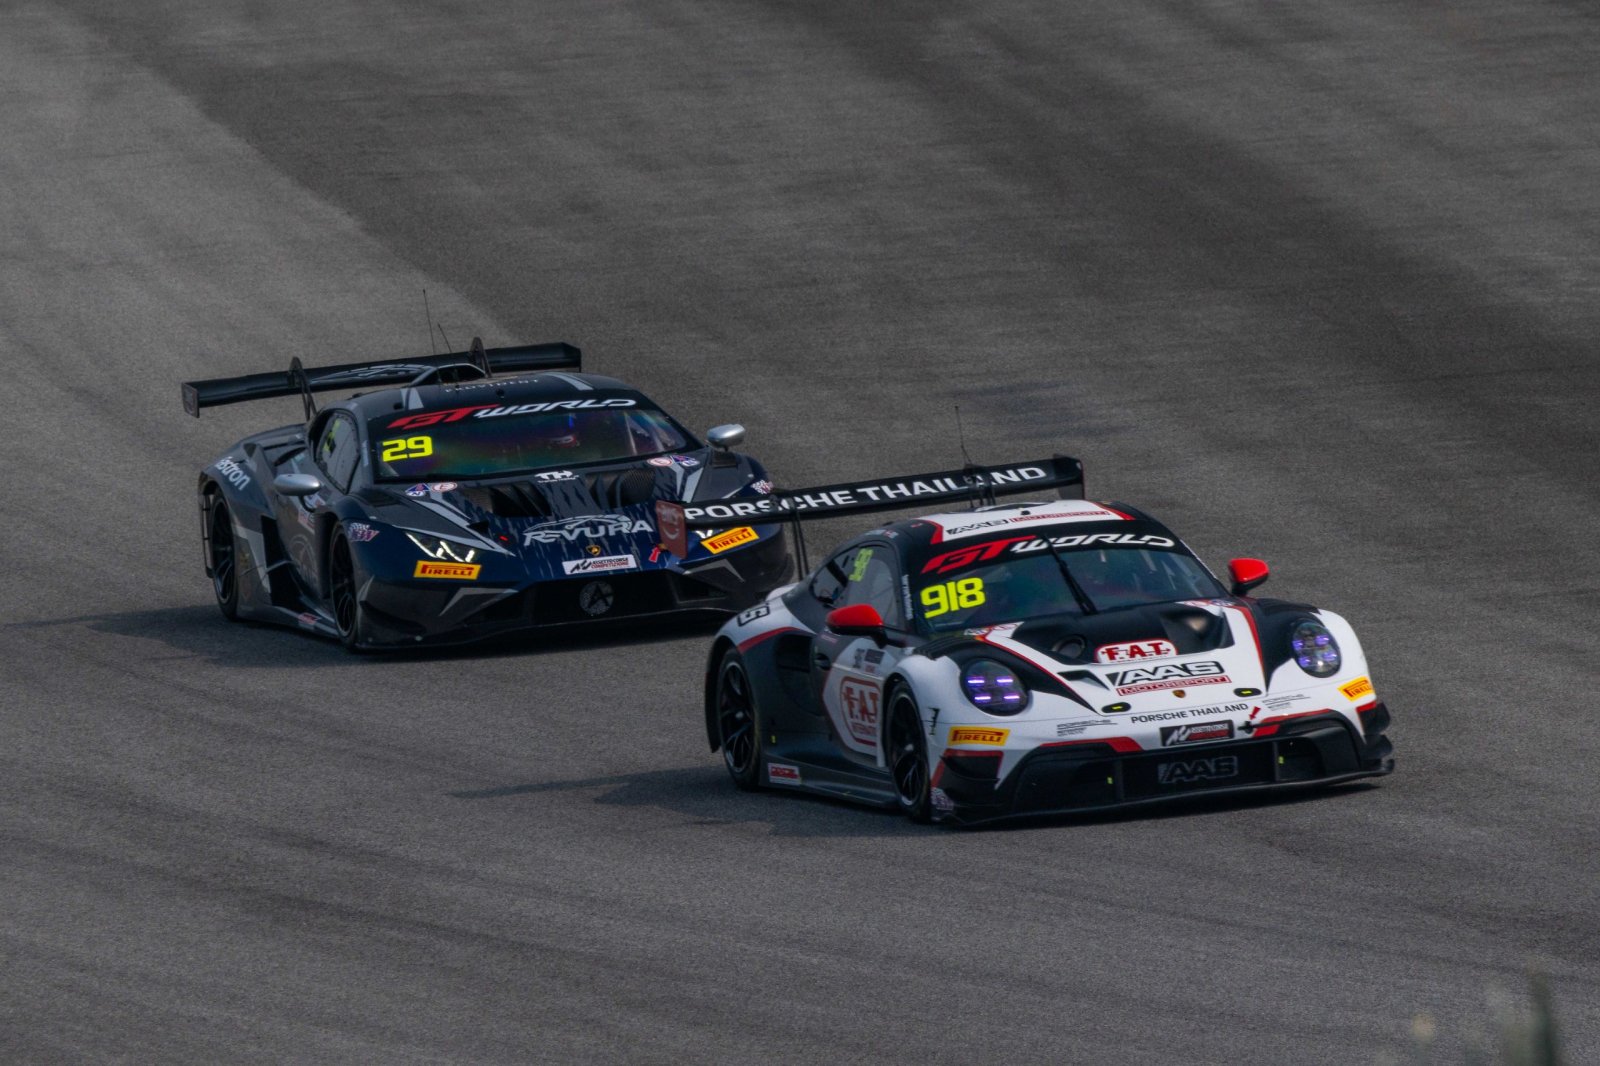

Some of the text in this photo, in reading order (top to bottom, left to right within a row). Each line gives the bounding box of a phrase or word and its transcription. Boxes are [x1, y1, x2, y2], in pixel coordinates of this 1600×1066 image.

[387, 399, 637, 430] GT WORLD
[382, 436, 433, 462] 29
[683, 490, 859, 520] PORSCHE
[857, 466, 1047, 501] THAILAND
[523, 519, 655, 547] REVURA
[708, 528, 753, 550] PIRELLI
[921, 533, 1176, 574] GT WORLD
[420, 564, 475, 577] PIRELLI
[921, 577, 986, 619] 918
[1106, 661, 1225, 687] AAS
[1131, 710, 1189, 724] PORSCHE
[1189, 702, 1249, 717] THAILAND
[951, 729, 1005, 743] PIRELLI
